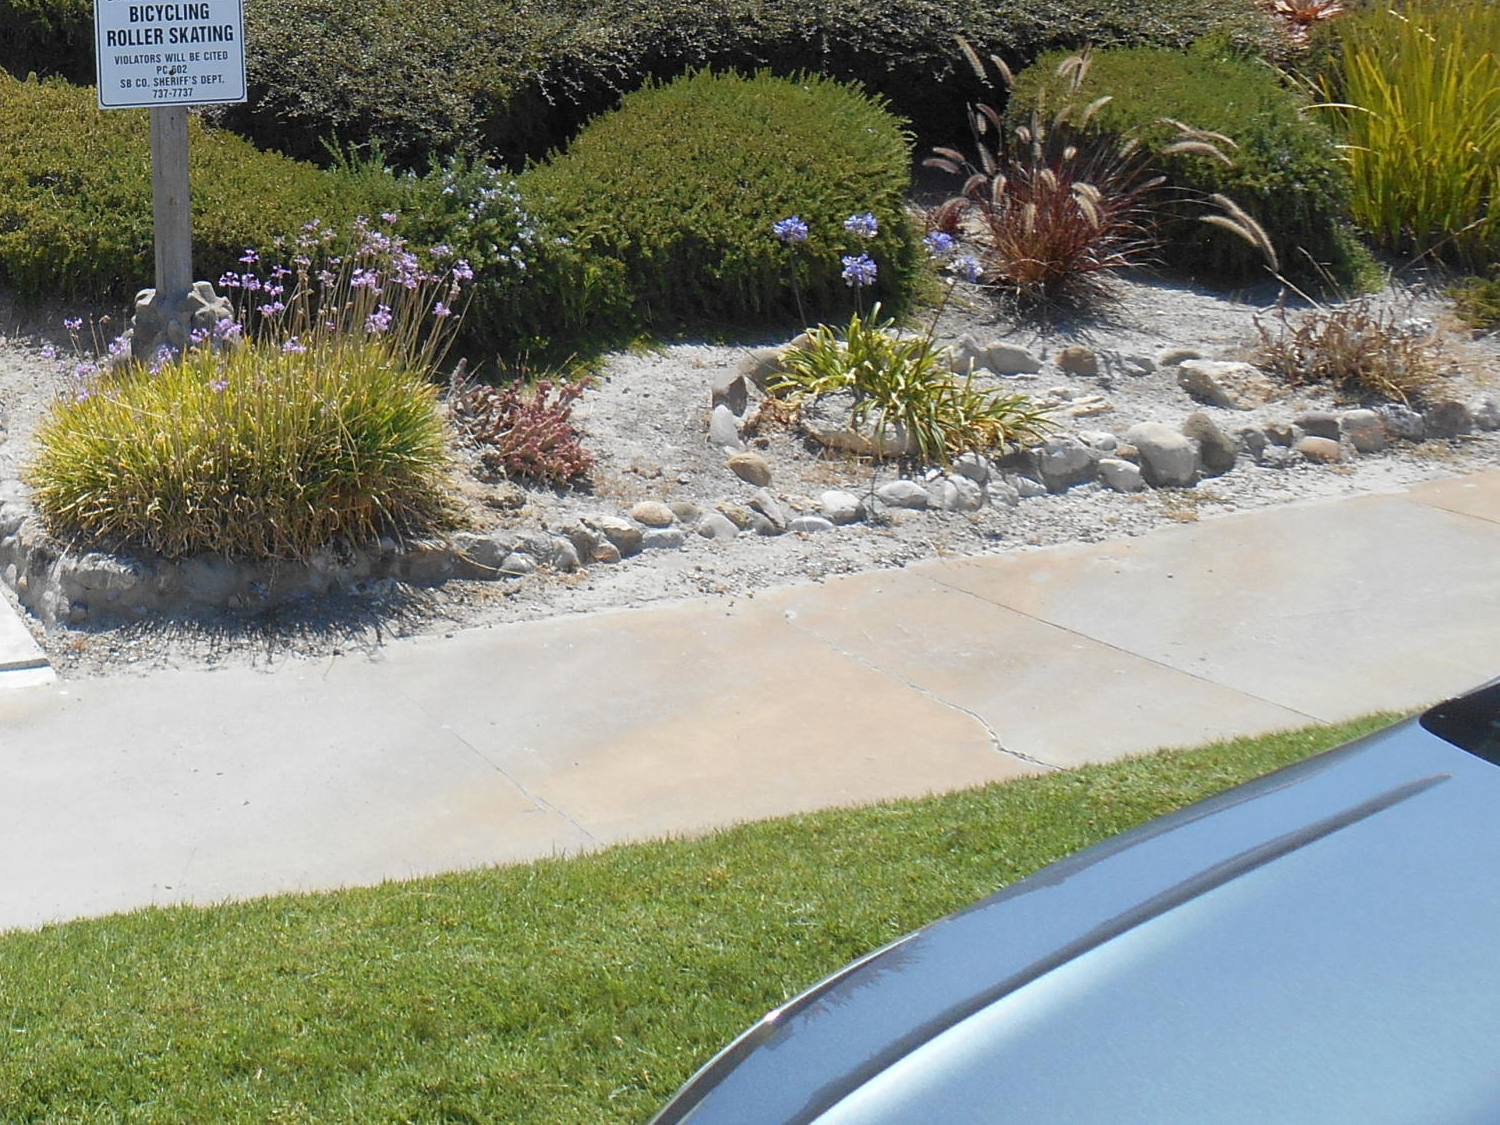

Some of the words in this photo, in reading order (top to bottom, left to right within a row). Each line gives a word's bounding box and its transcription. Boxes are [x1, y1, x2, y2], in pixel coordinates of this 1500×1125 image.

[129, 3, 210, 23] BICYCLING
[107, 28, 164, 47] ROLLER
[169, 25, 234, 44] SKATING
[114, 53, 162, 65] VIOLATORS
[164, 53, 186, 62] WILL
[190, 52, 201, 61] BE
[203, 51, 228, 60] CITED
[156, 65, 167, 74] PC
[172, 65, 188, 74] 602
[120, 80, 133, 88] SB
[136, 79, 150, 87] CO.
[153, 77, 198, 86] SHERIFF'S
[201, 75, 225, 84] DEPT.
[153, 88, 193, 98] 737-7737
